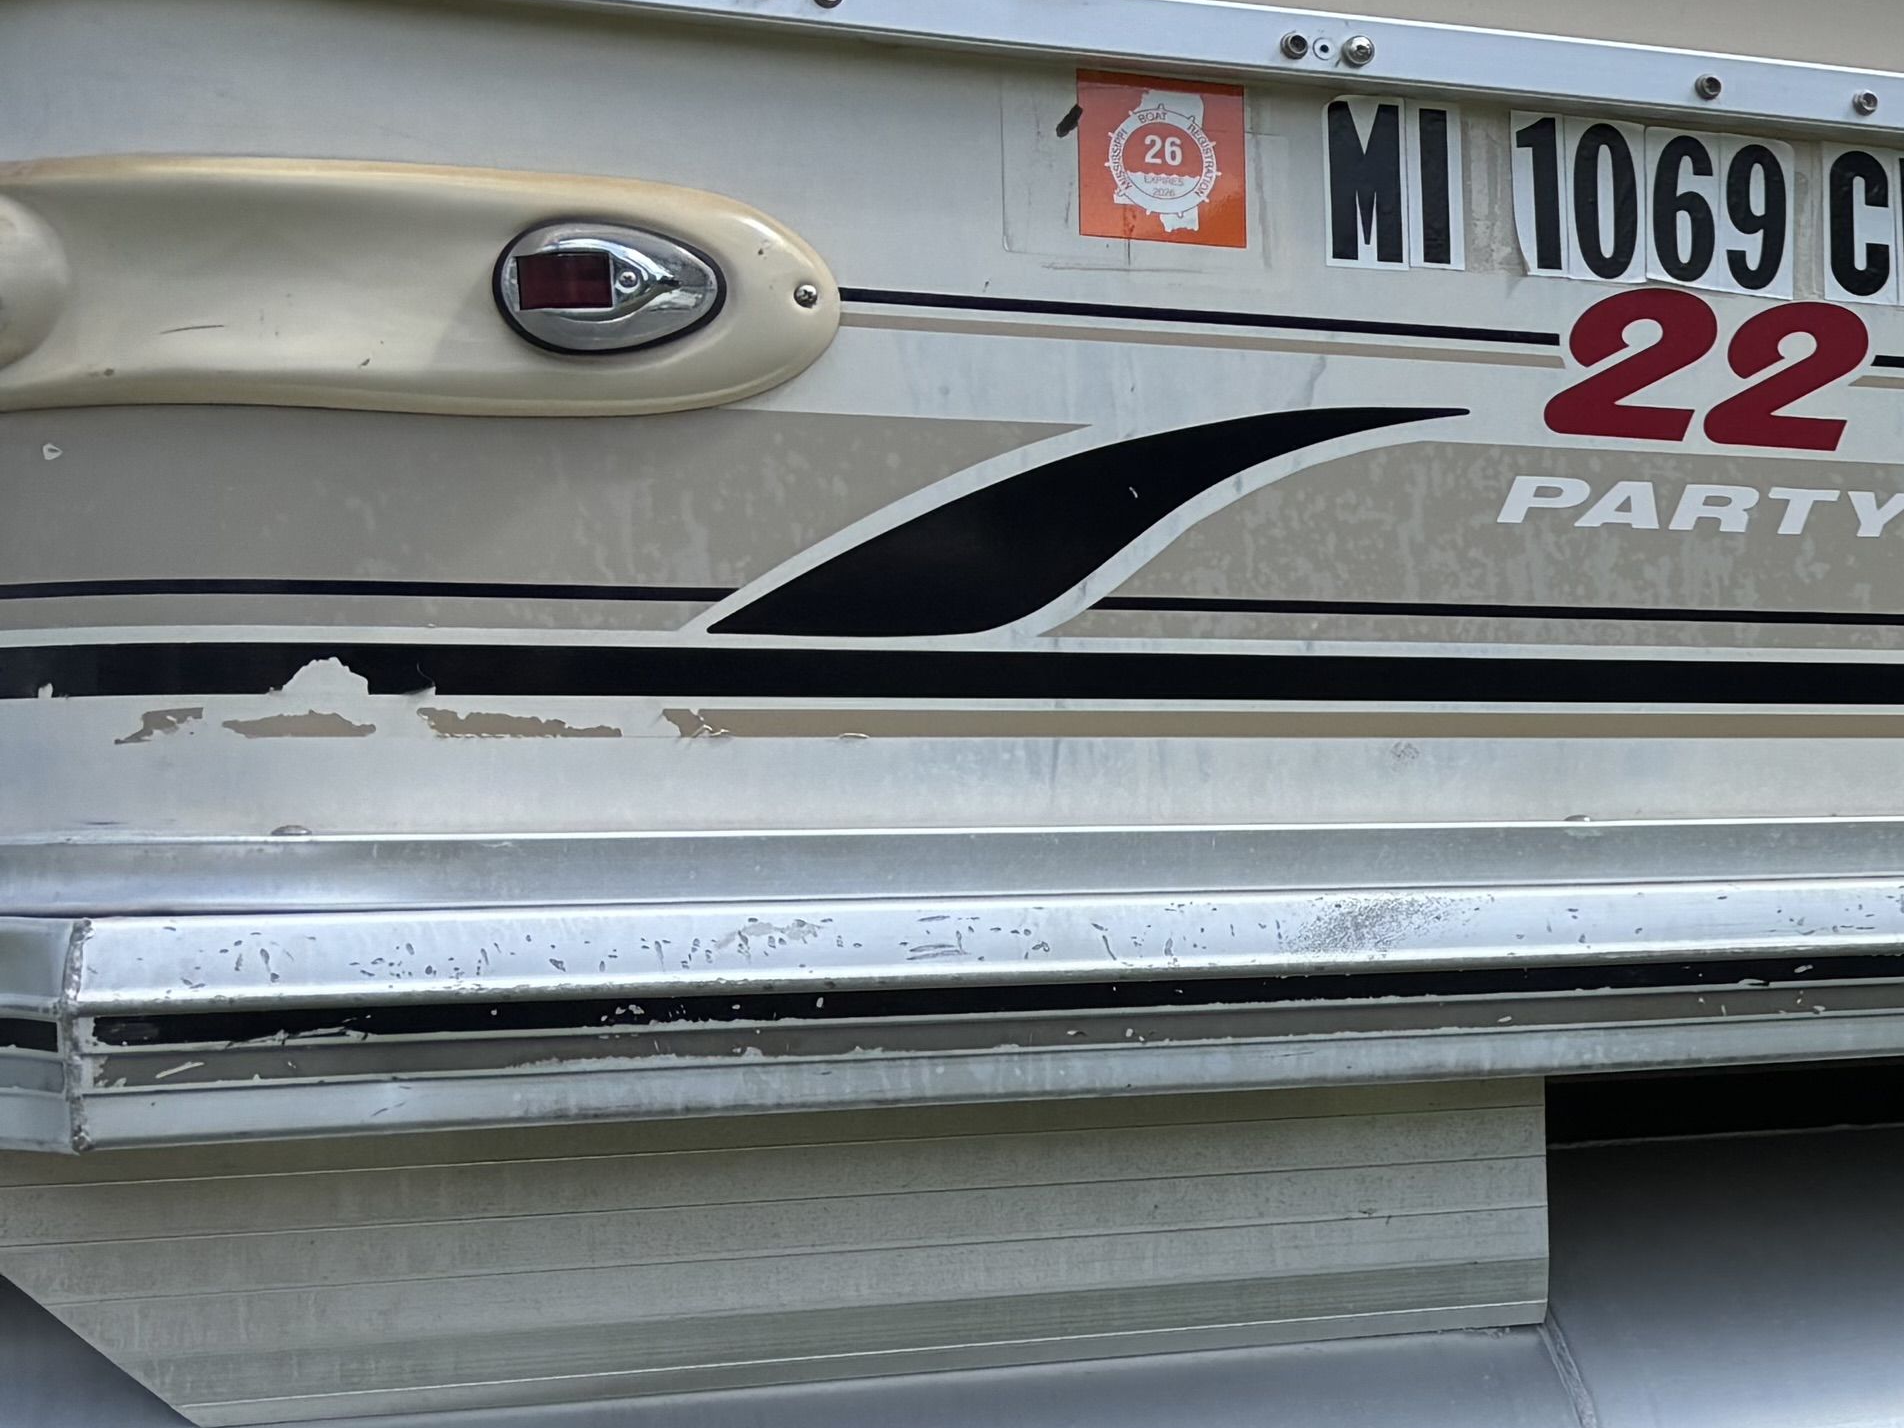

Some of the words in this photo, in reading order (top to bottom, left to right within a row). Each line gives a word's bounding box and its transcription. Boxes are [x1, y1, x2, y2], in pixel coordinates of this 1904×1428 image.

[1137, 111, 1168, 123] BOAT
[1186, 124, 1214, 197] REGISTRATION
[1144, 134, 1183, 166] 26
[1143, 175, 1185, 187] EXPIRES
[1152, 187, 1177, 198] 2026
[1328, 100, 1452, 265] MI
[1515, 116, 1789, 291] 1069
[1543, 287, 1870, 452] 22
